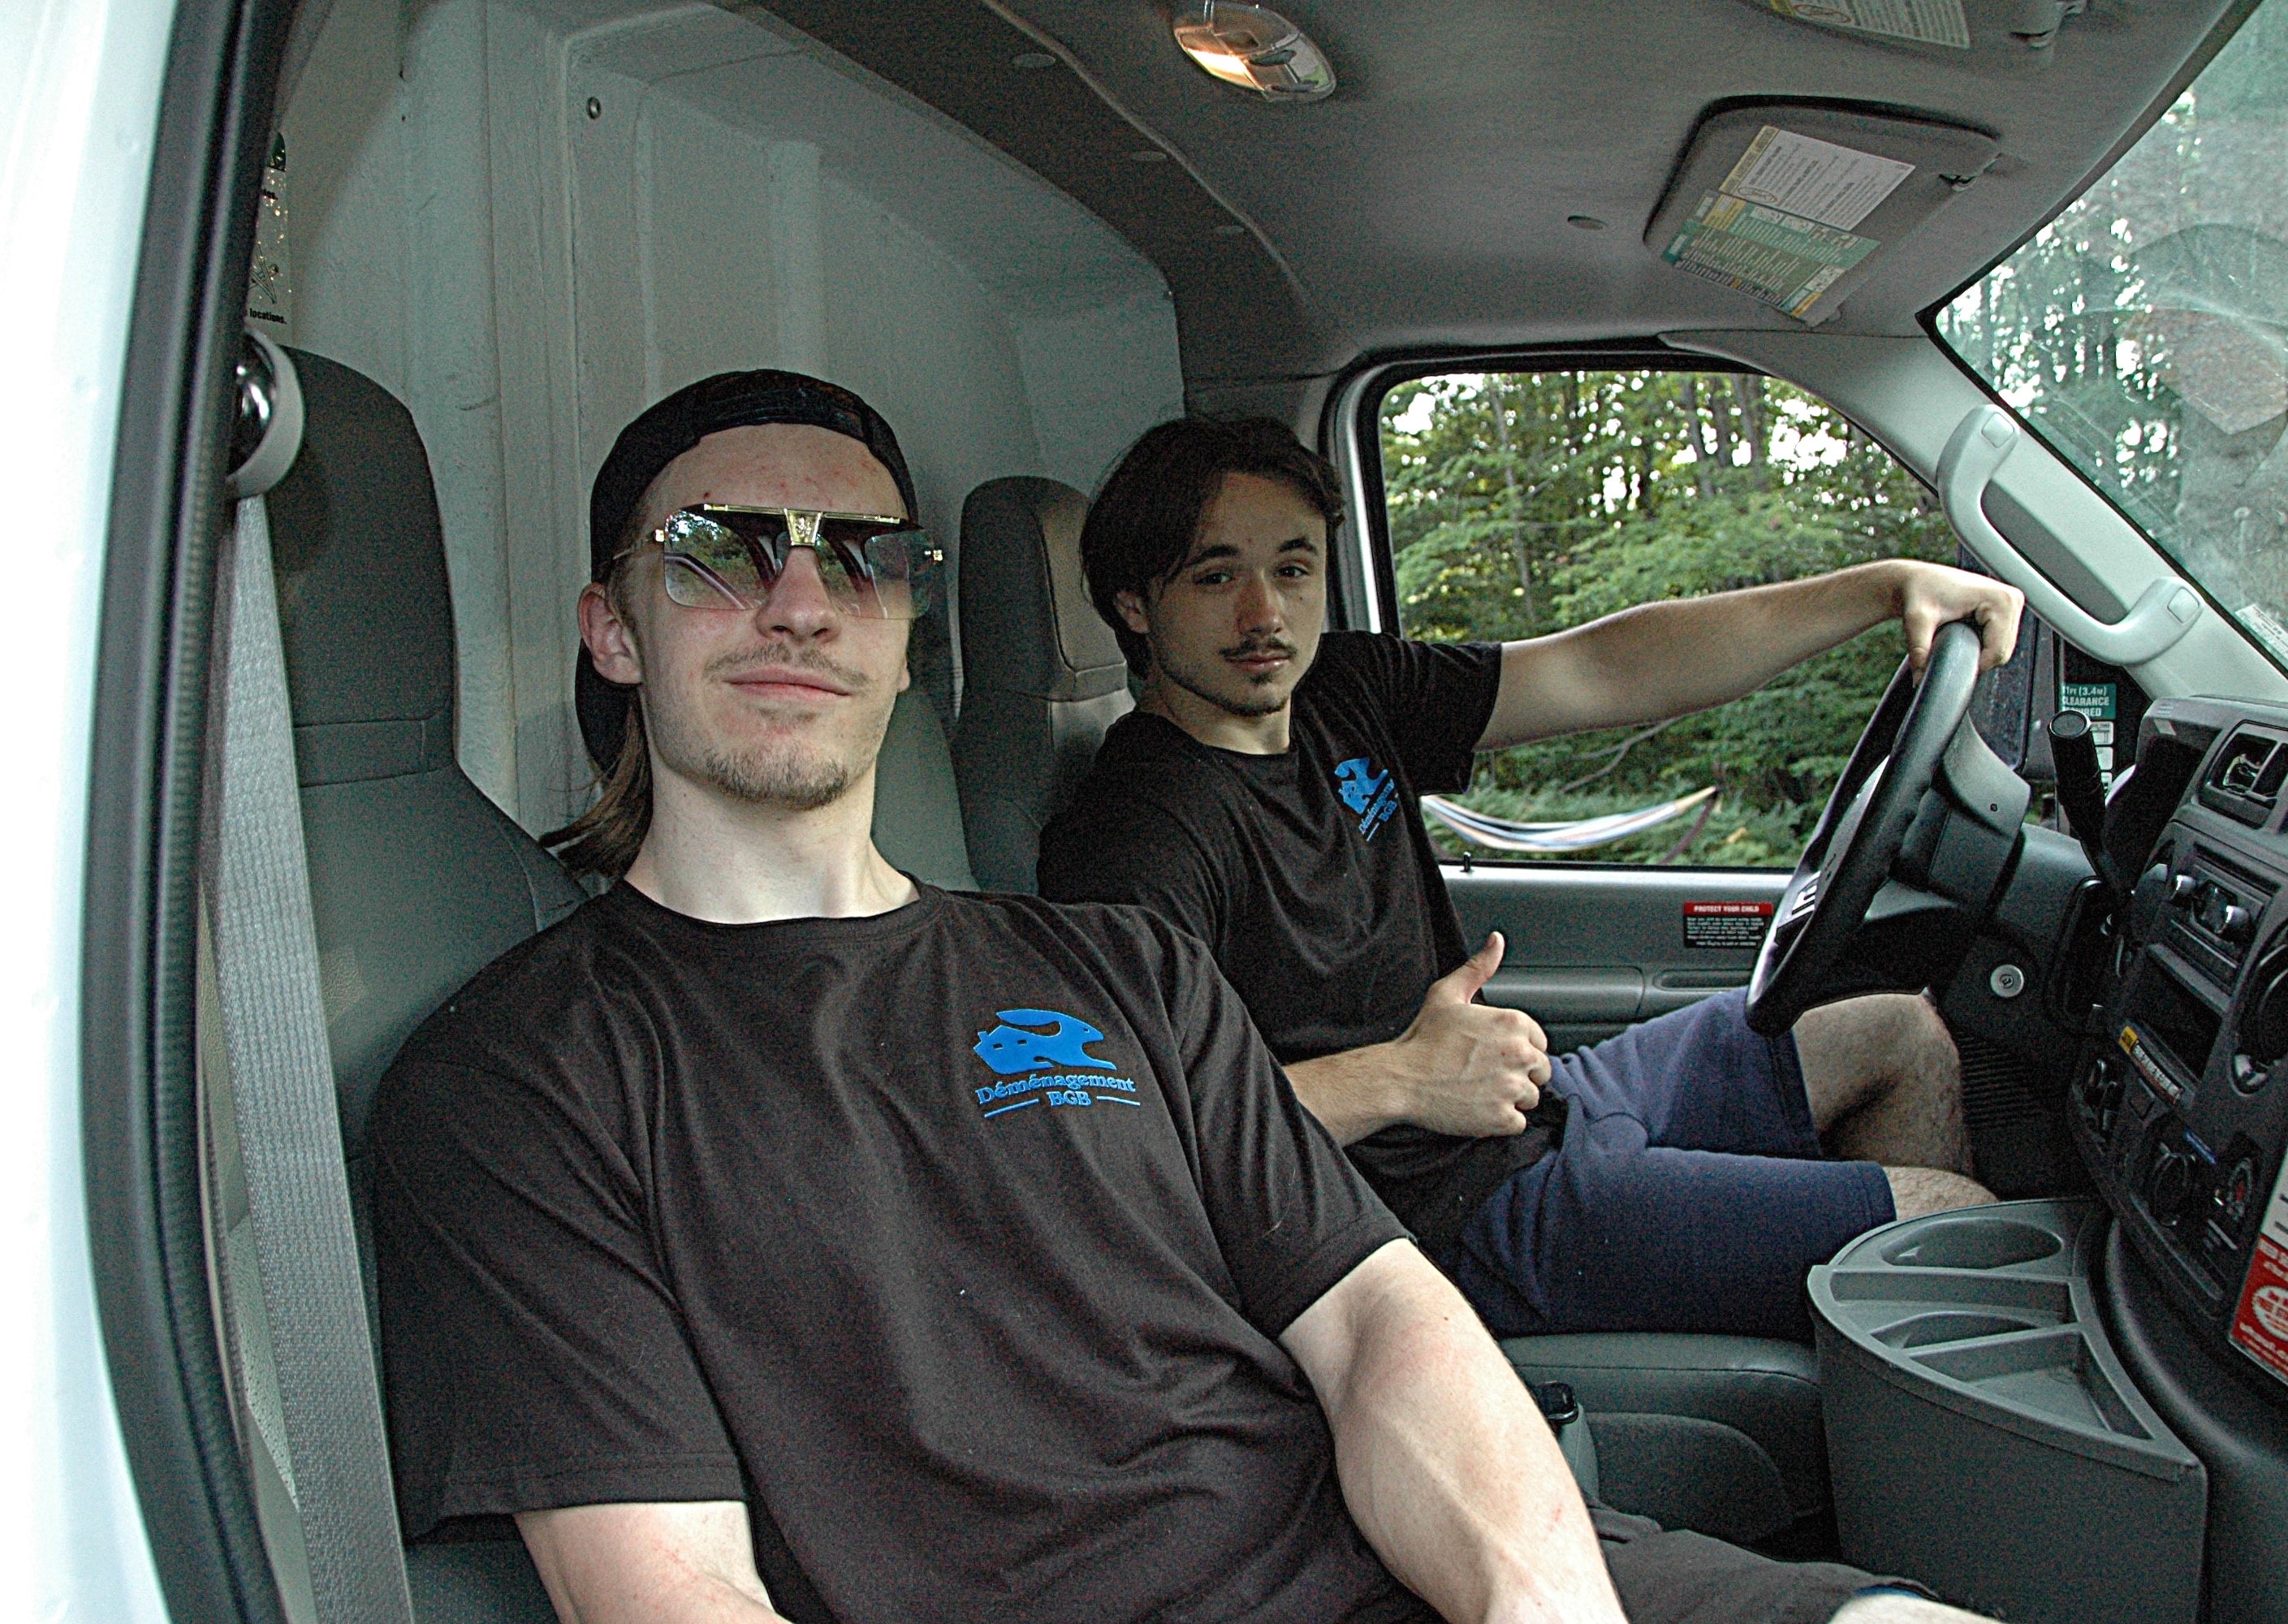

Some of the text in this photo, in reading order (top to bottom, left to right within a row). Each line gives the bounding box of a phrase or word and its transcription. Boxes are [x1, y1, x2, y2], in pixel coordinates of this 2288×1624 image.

[2062, 696, 2109, 706] CLEARANCE
[1694, 905, 1759, 913] PROTECT YOUR CHILD
[975, 1073, 1137, 1105] Déménagement
[1047, 1091, 1092, 1107] BGB
